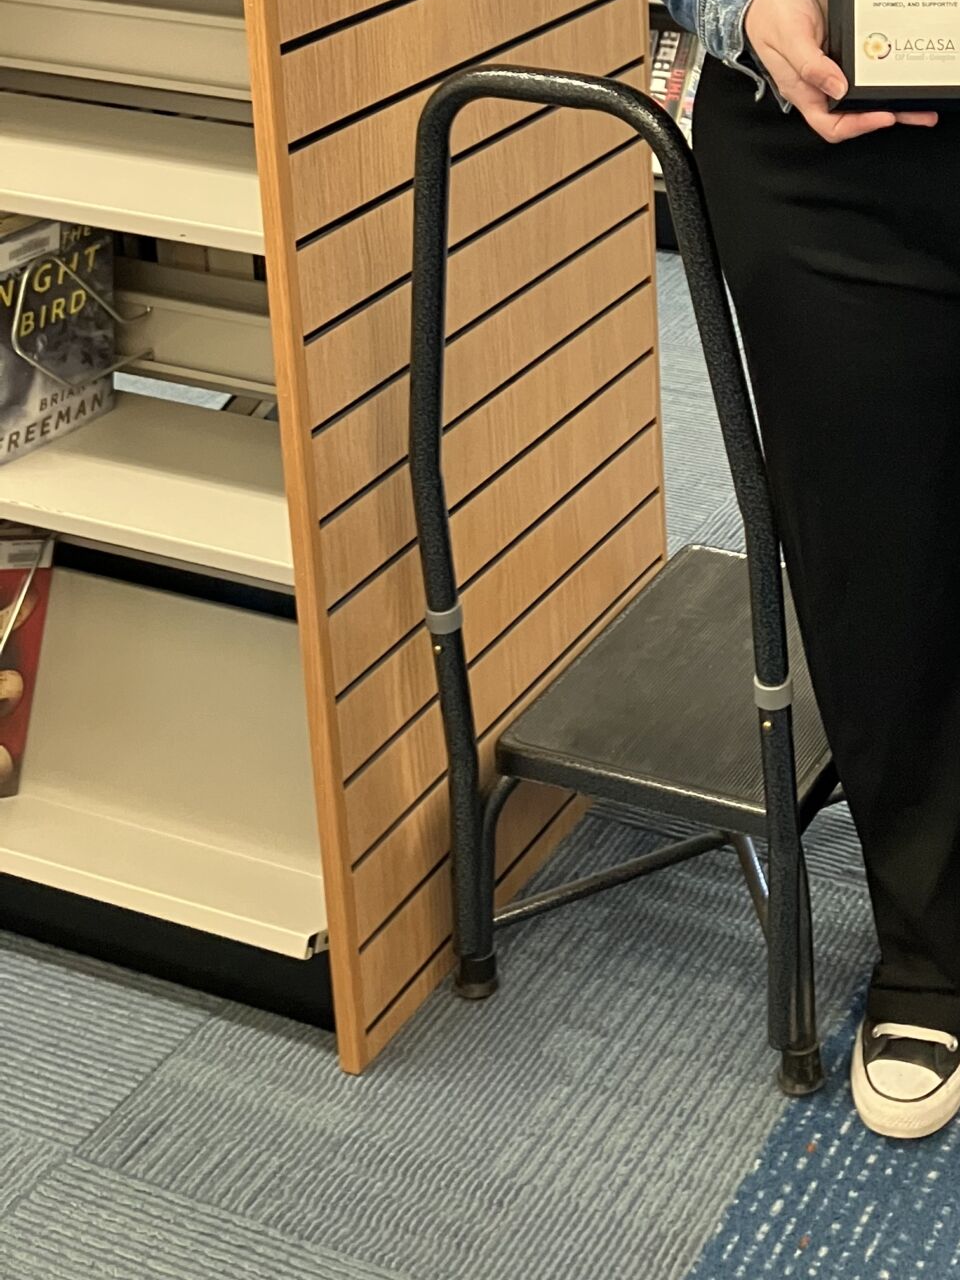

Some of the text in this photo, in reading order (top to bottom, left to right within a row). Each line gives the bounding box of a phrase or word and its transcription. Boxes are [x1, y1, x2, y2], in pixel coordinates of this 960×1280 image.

[895, 38, 956, 51] LACASA
[62, 225, 92, 246] THE
[0, 244, 101, 308] NGHT
[20, 289, 86, 337] BIRD
[40, 380, 98, 412] BRIA
[0, 389, 104, 453] REEMAN
